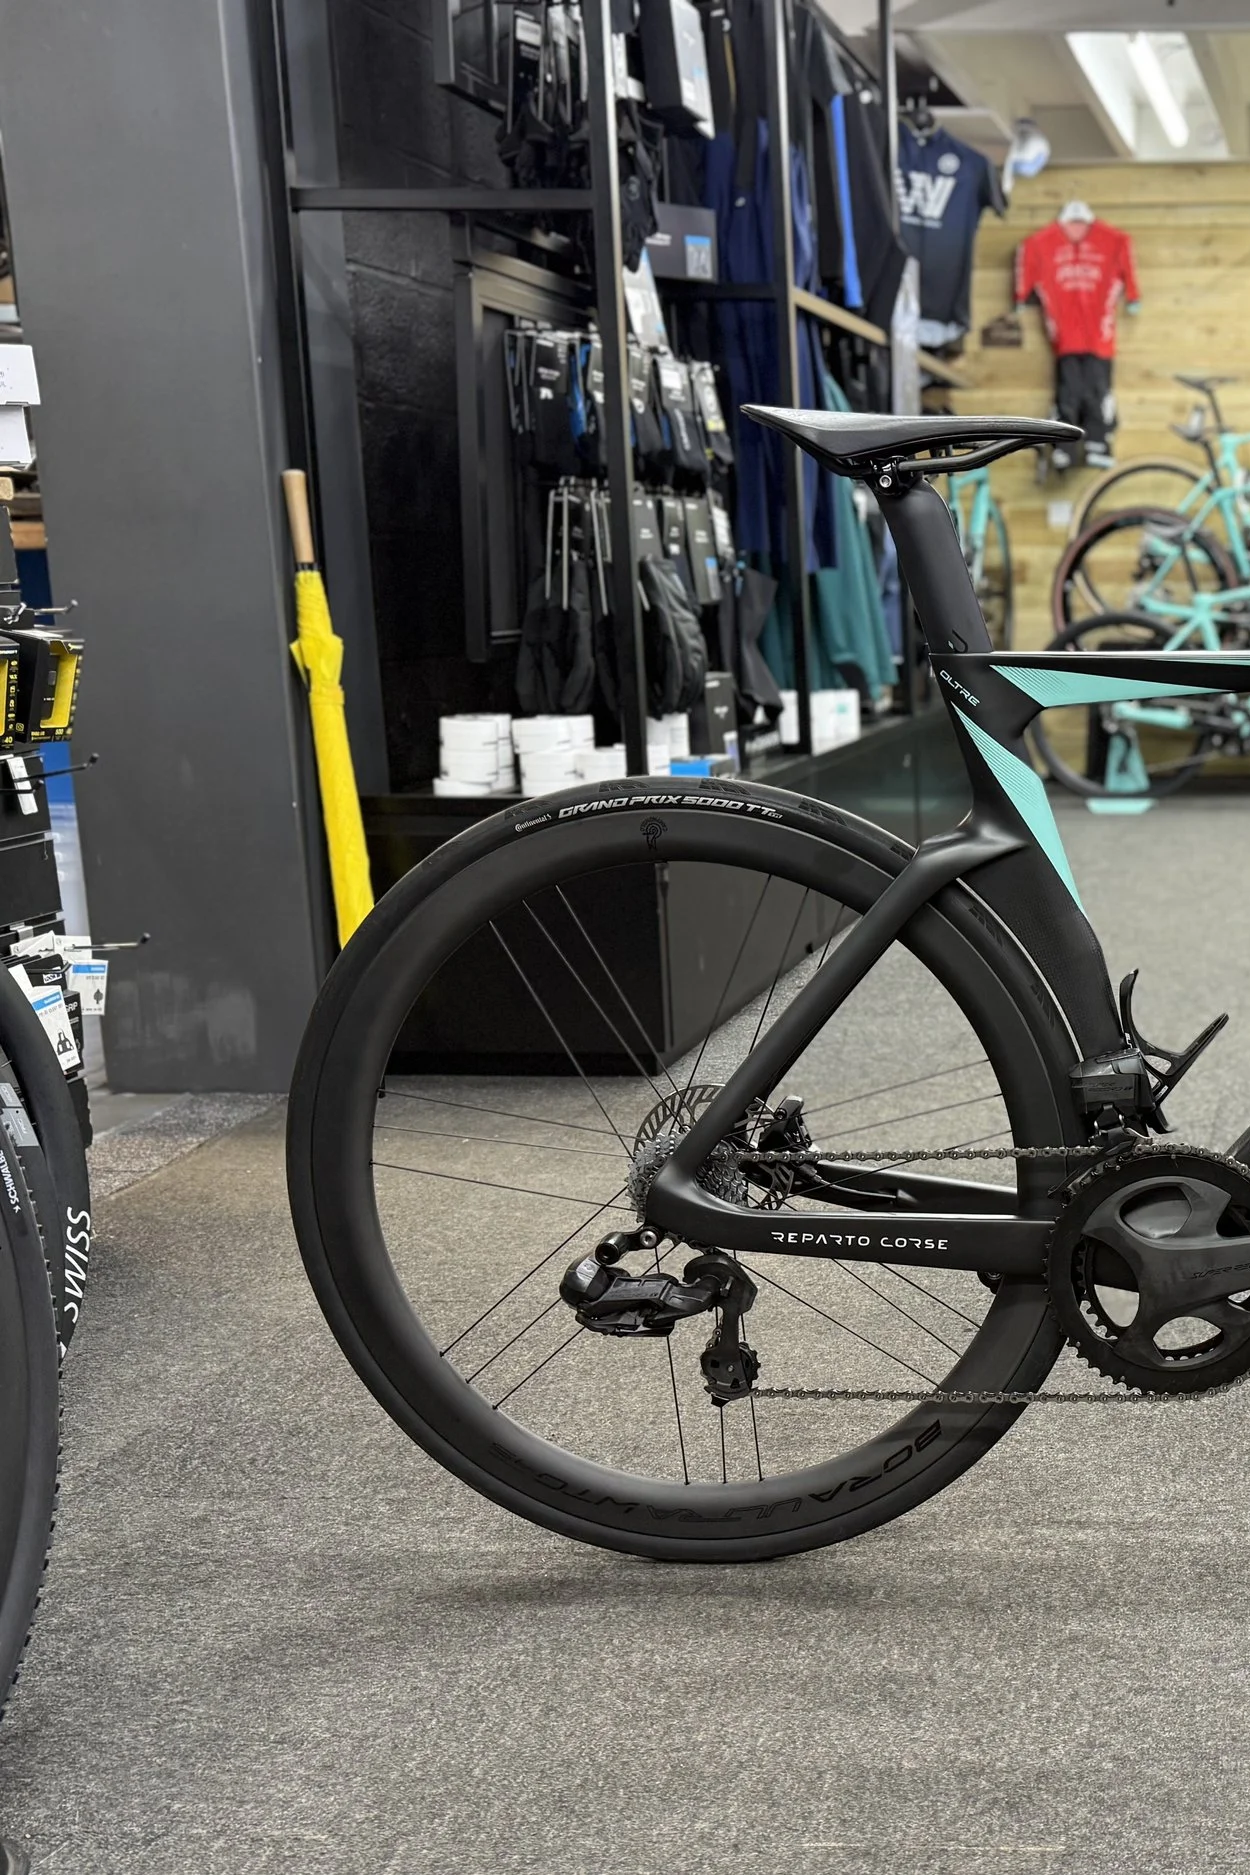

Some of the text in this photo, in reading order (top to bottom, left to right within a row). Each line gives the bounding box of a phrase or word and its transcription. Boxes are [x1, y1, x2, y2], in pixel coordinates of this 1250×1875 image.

[939, 669, 981, 707] OLTRE
[557, 797, 631, 820] GRAND
[629, 795, 683, 806] PRIX
[680, 795, 745, 809] 5000
[514, 815, 549, 832] Continental
[771, 1231, 949, 1250] REPARTO CORSE
[63, 1206, 91, 1324] SWISS
[808, 1419, 943, 1504] BORA
